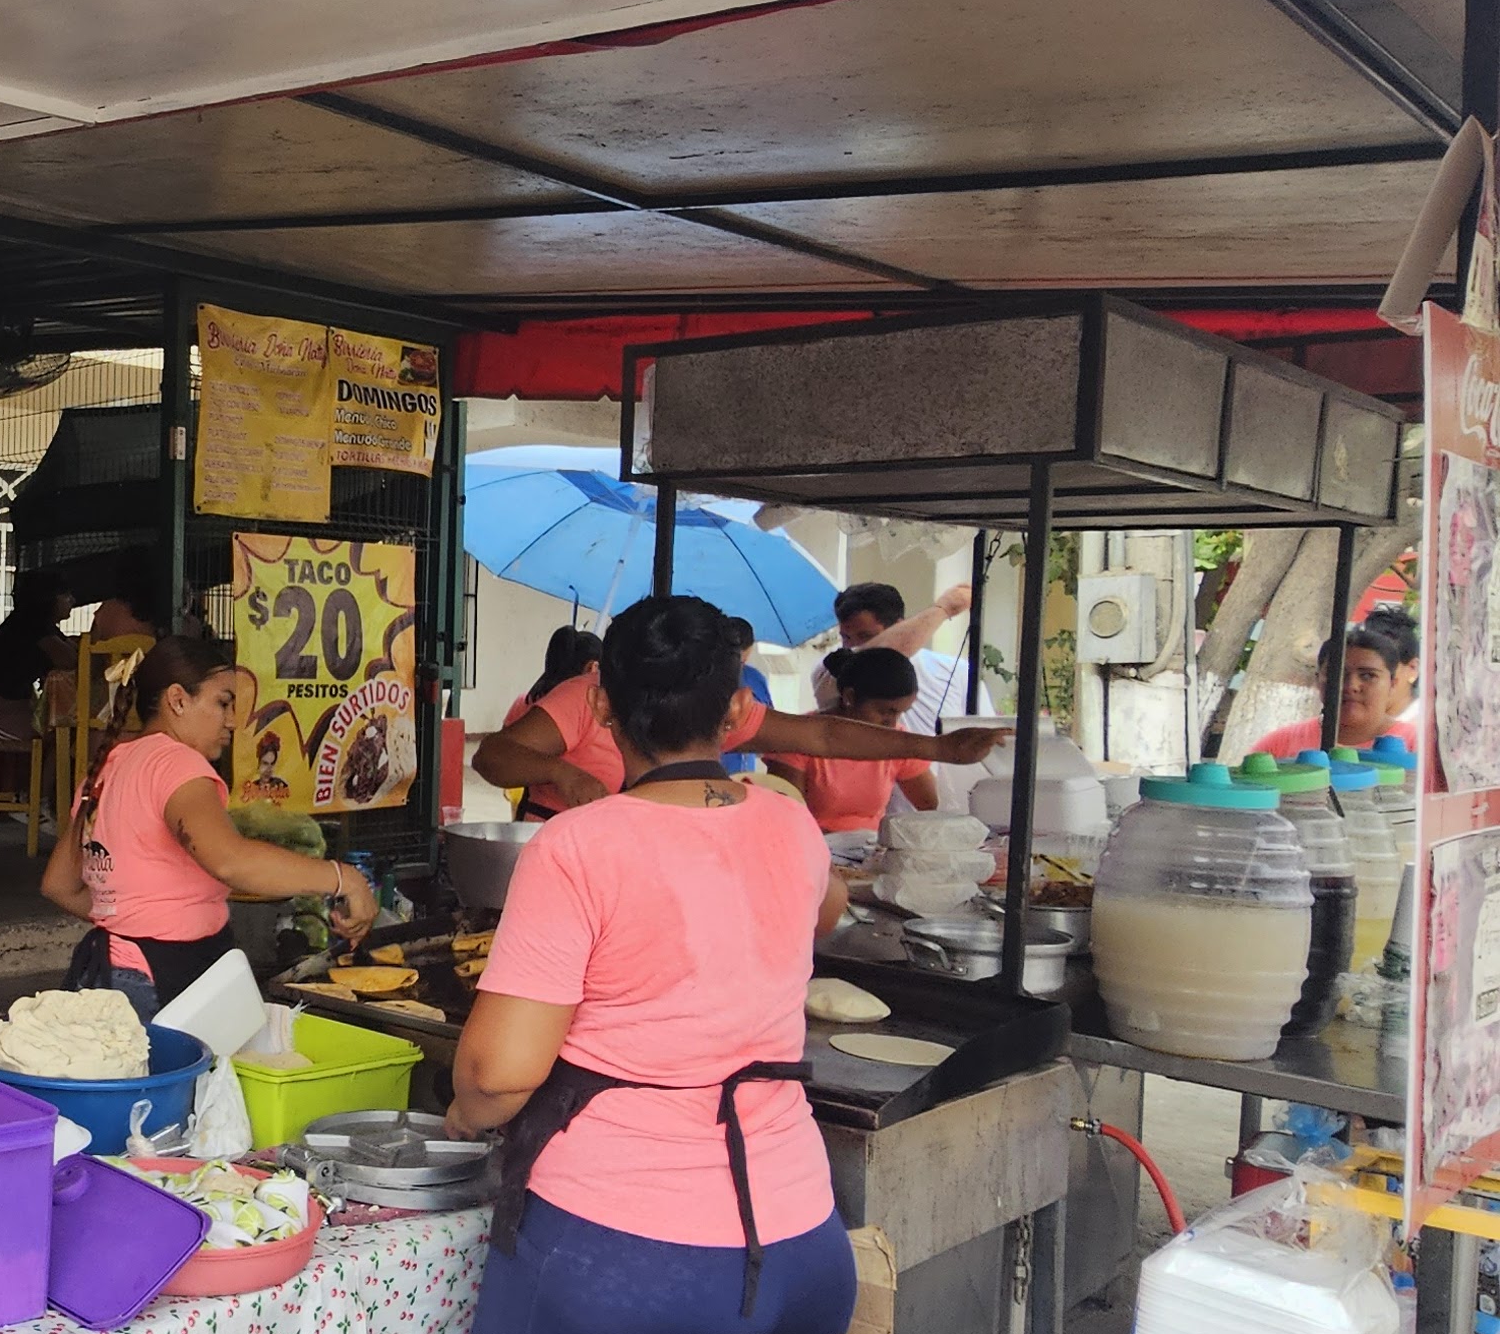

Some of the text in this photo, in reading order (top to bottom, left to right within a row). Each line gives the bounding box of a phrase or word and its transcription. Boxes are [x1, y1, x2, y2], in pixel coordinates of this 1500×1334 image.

[337, 378, 437, 416] DOMINGOS
[283, 558, 350, 586] TACO
[287, 683, 348, 698] PESITOS
[315, 679, 409, 804] BIEN SURTIDOS
